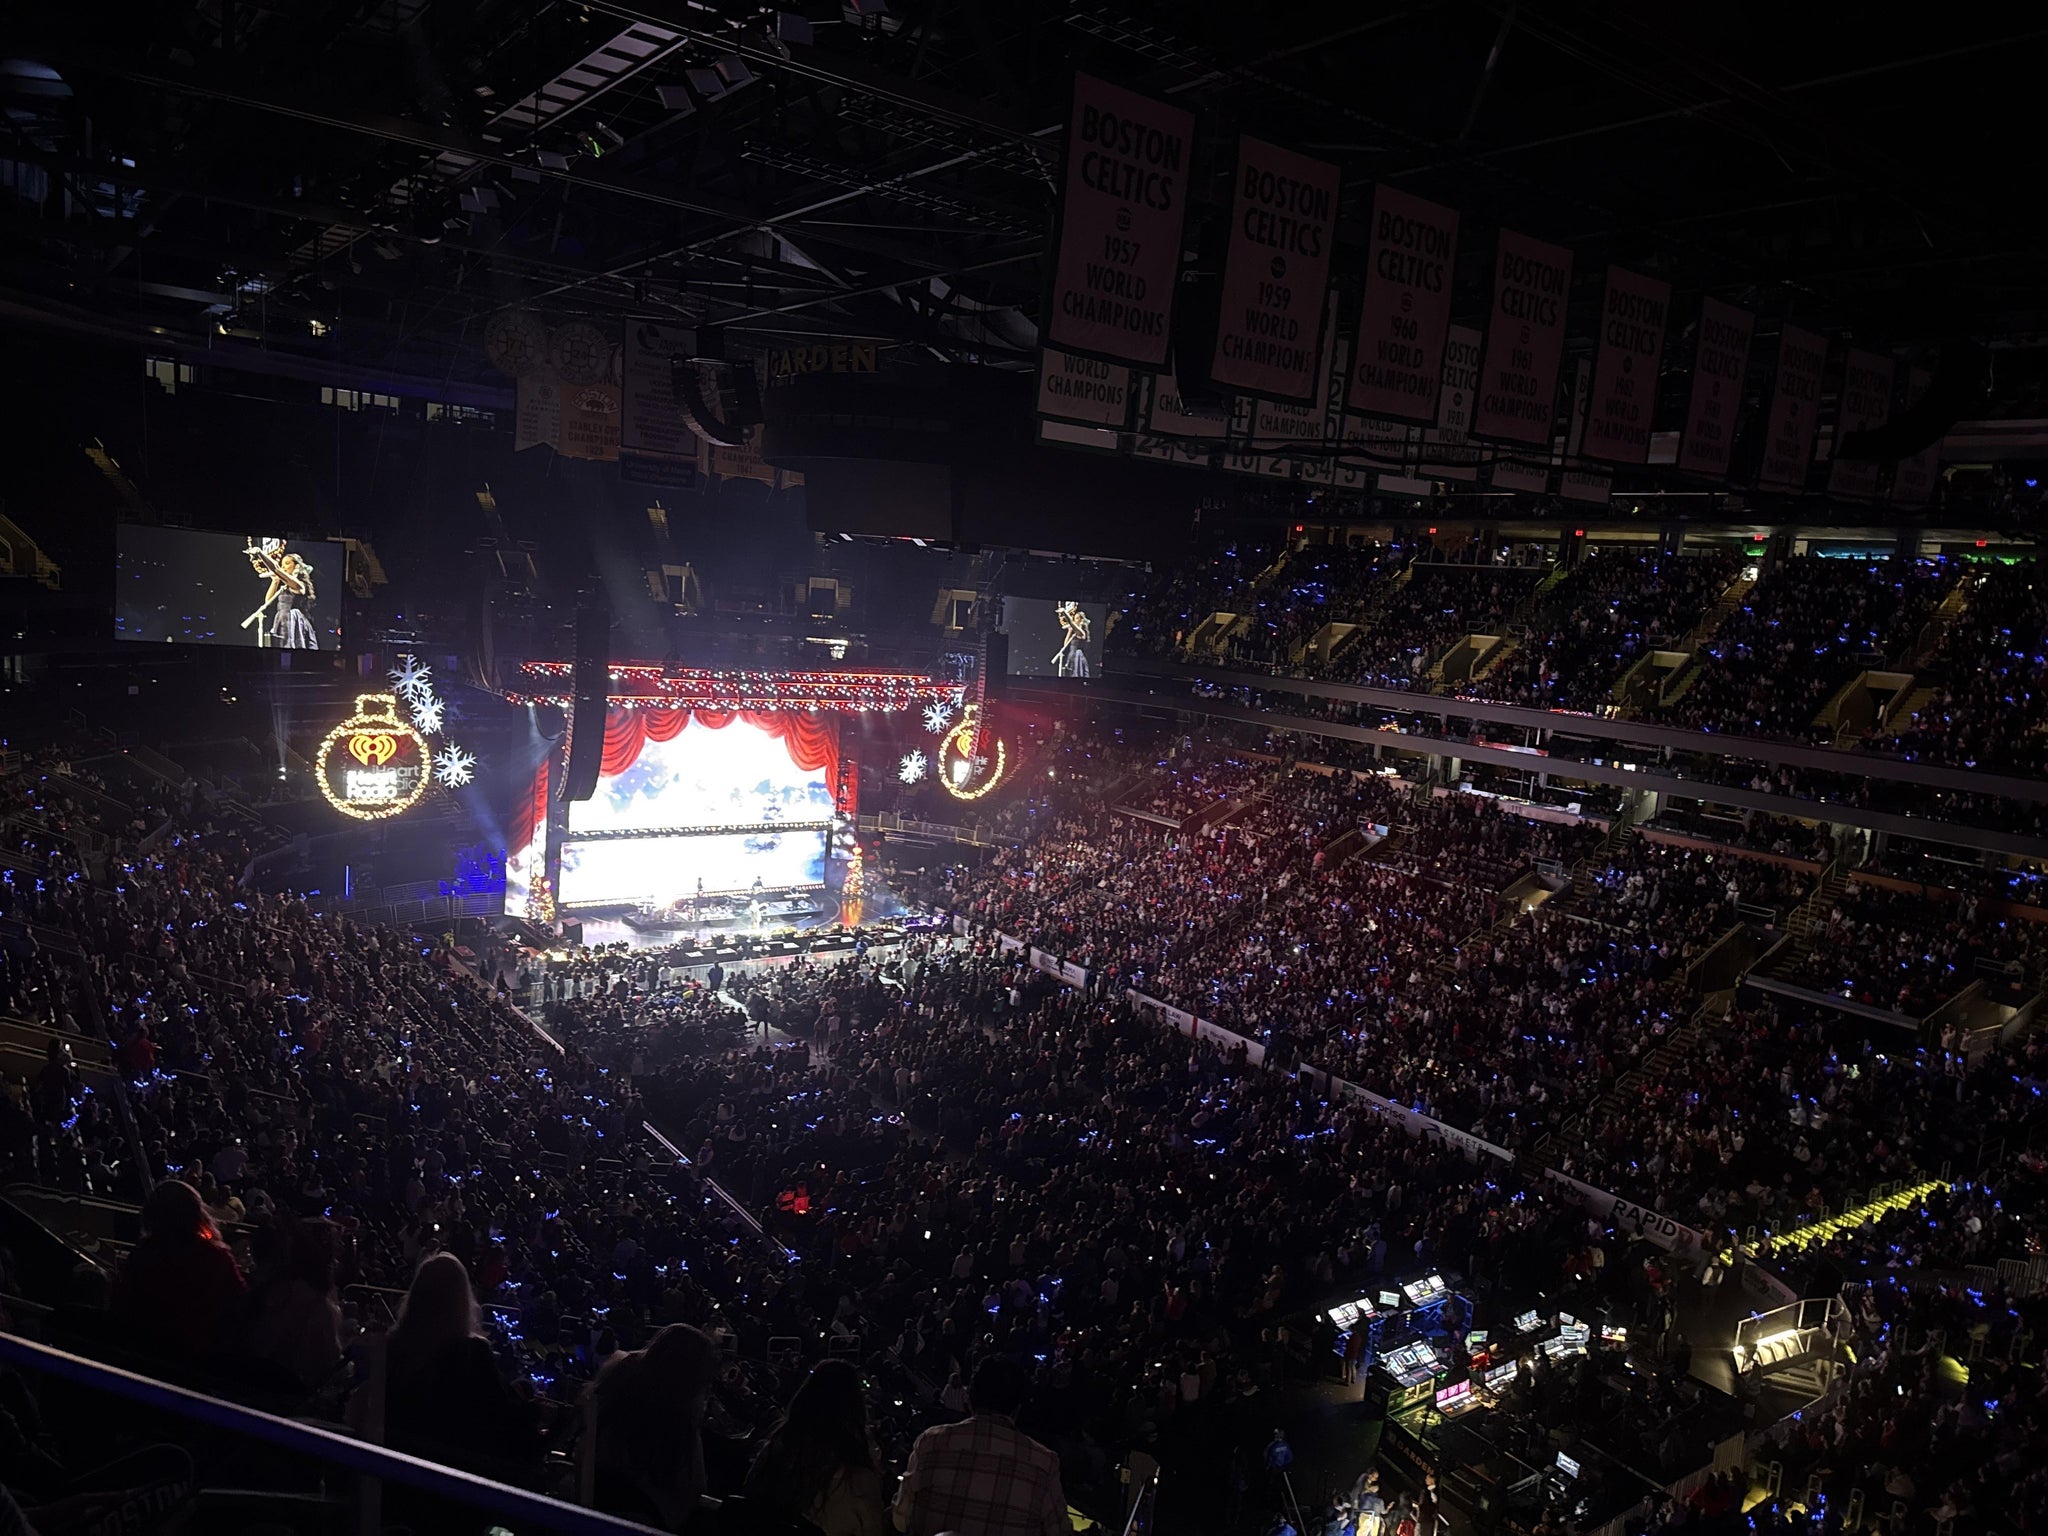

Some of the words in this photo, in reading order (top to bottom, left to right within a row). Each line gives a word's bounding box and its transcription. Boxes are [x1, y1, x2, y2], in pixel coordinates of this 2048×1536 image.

[1081, 104, 1182, 173] BOSTON
[1081, 151, 1173, 212] CELTICS
[1244, 164, 1330, 222] BOSTON
[1244, 207, 1323, 258] CELTICS
[1378, 210, 1450, 260] BOSTON
[1104, 234, 1141, 267] 1957
[1086, 262, 1146, 301] WORLD
[1377, 248, 1444, 294] CELTICS
[1502, 251, 1566, 297] BOSTON
[1258, 281, 1292, 311] 1959
[1500, 286, 1557, 327] CELTICS
[1607, 287, 1664, 328] BOSTON
[1063, 290, 1165, 337] CHAMPIONS
[1245, 308, 1298, 342] WORLD
[1390, 314, 1418, 341] 1960
[1222, 333, 1312, 373] CHAMPIONS
[1378, 340, 1424, 369] WORLD
[1448, 340, 1479, 368] OSTO
[1606, 319, 1657, 357] CELTICS
[768, 344, 878, 378] GARDEN
[1063, 353, 1110, 380] WORLD
[1510, 348, 1533, 372] 1961
[1701, 347, 1740, 381] CELTICS
[1047, 374, 1123, 405] CHAMPIONS
[1358, 362, 1434, 398] CHAMPIONS
[1442, 368, 1478, 391] ELTIC
[1500, 371, 1538, 397] WORLD
[1484, 394, 1549, 423] CHAMPIONS
[1606, 398, 1639, 421] WORLD
[567, 431, 620, 447] CHAMPIONS
[1259, 413, 1321, 439] CHAMPIONS
[721, 451, 762, 465] CHAMPIO
[1443, 1128, 1489, 1150] SYMETR
[1396, 1439, 1435, 1476] GARDEN
